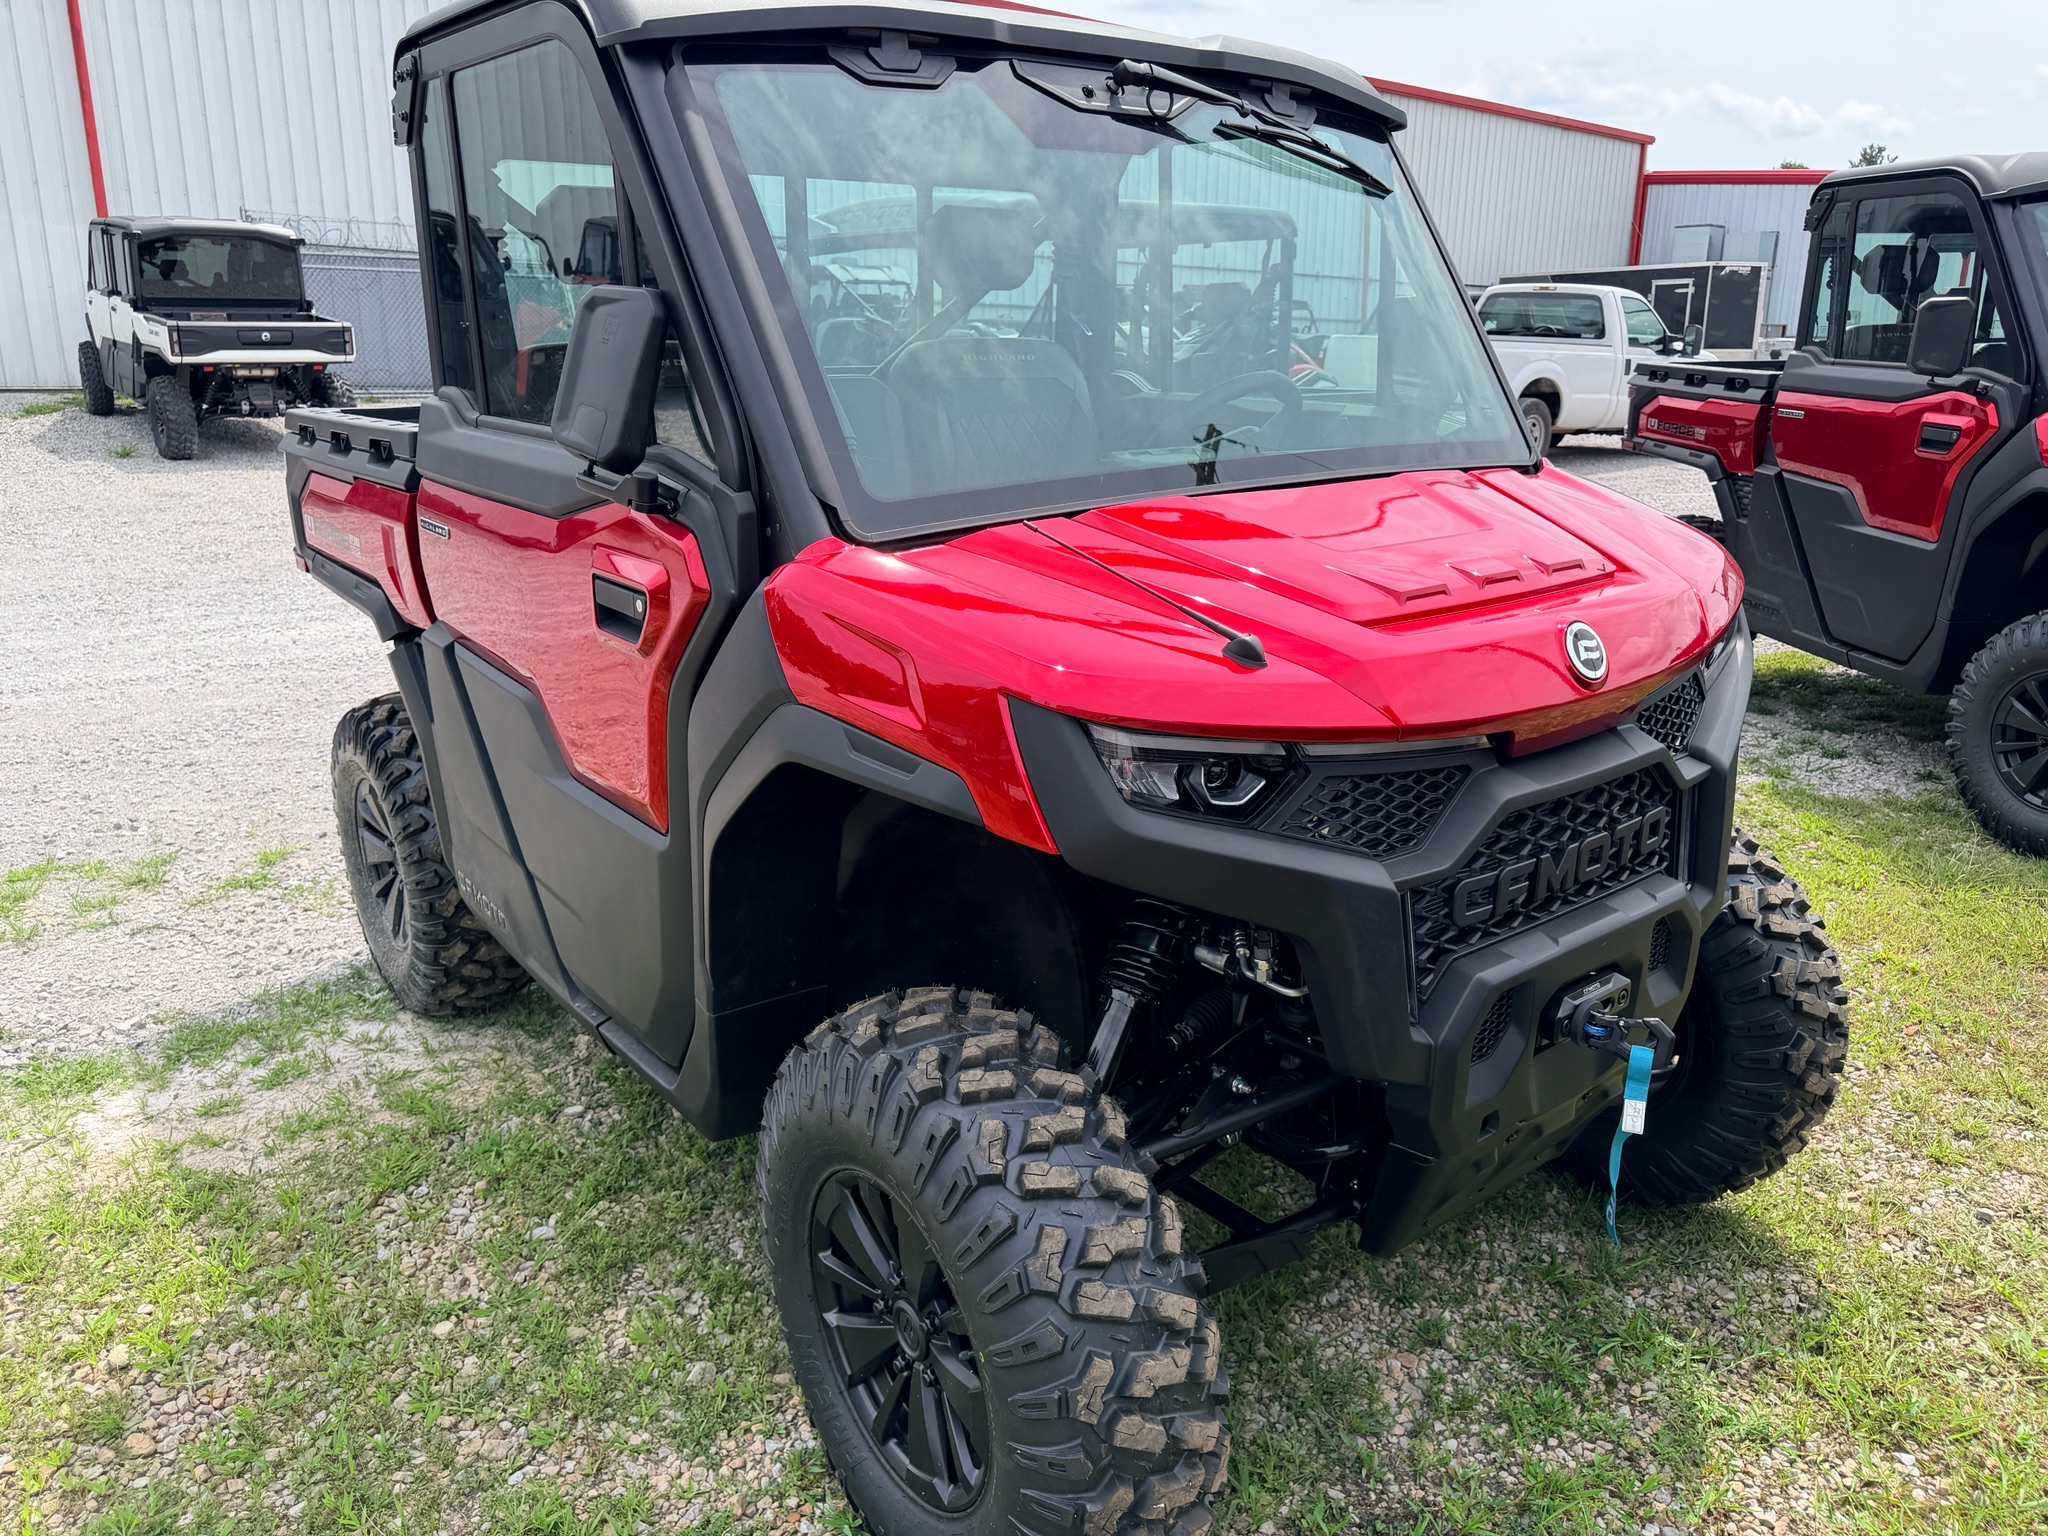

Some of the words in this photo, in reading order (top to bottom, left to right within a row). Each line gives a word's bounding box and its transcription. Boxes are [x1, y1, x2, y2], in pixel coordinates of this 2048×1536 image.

[420, 520, 447, 536] HIGHLAND
[1453, 806, 1666, 927] CFMOTO
[457, 869, 508, 934] CFMOTO
